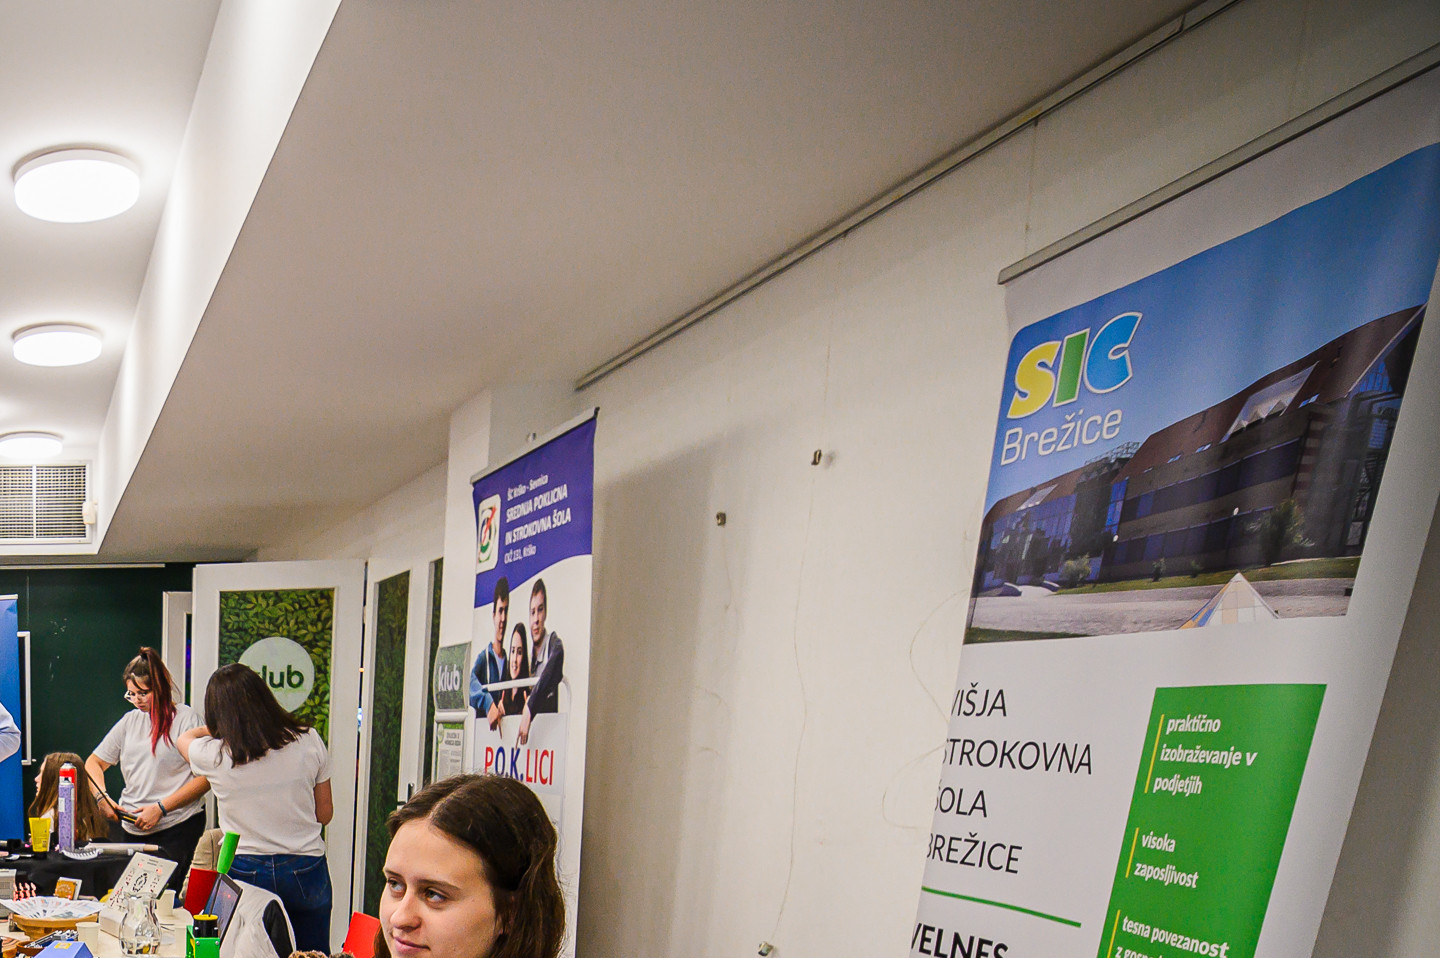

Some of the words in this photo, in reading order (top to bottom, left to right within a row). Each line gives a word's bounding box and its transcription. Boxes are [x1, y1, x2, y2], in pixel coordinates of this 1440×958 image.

[1007, 311, 1143, 420] SIC
[1000, 408, 1123, 466] Brežice
[506, 500, 533, 523] SREDNJA
[534, 484, 568, 511] POKLICNA
[505, 530, 513, 546] IN
[513, 515, 552, 543] STROKOVNA
[552, 507, 572, 529] ŠOLA
[257, 664, 304, 689] lub
[438, 664, 460, 692] klub
[1166, 713, 1221, 735] praktično
[1160, 744, 1241, 769] izobraževanje
[1246, 752, 1258, 766] v
[935, 779, 988, 818] OLA
[1153, 774, 1202, 797] podjetjih
[1141, 831, 1176, 852] visoka
[1134, 862, 1199, 889] zaposljivost
[1122, 915, 1150, 938] tesna
[1115, 946, 1122, 958] z
